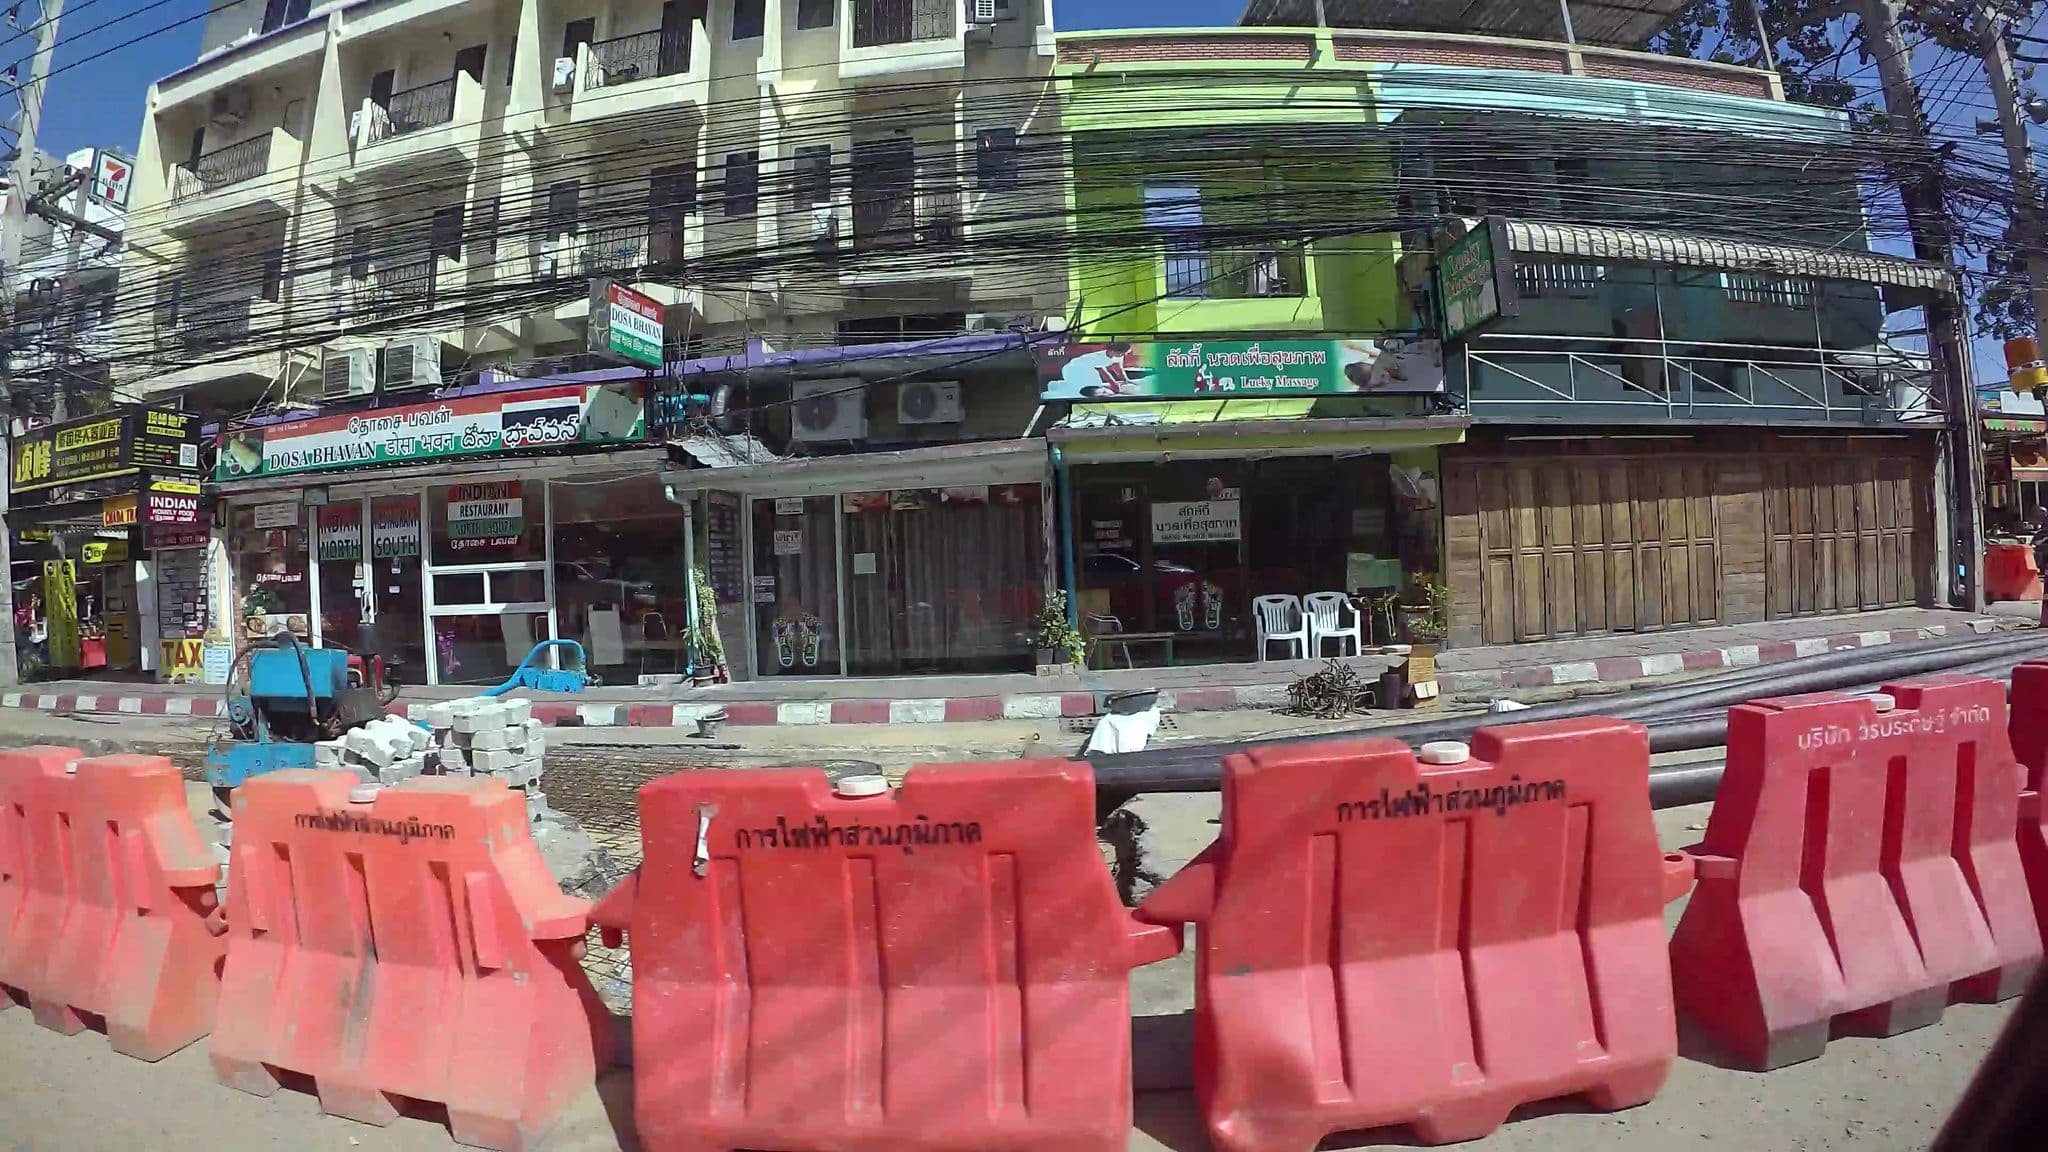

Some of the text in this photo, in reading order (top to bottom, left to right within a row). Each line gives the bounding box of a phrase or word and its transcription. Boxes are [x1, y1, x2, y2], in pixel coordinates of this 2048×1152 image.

[612, 308, 662, 341] DOSA BHAVAN
[1207, 343, 1327, 371] นวดเพื่อสุขภาพ
[1240, 375, 1320, 391] Lucky Massage
[349, 406, 451, 438] தோசை பவன்
[386, 432, 454, 454] डोसा भवन
[270, 441, 377, 469] DOSA BHAVAN
[459, 481, 507, 499] INDIAN
[150, 496, 197, 510] INDIAN
[460, 503, 508, 517] RESTAURANT
[320, 538, 360, 558] NORTH
[376, 535, 417, 556] SOUTH
[1336, 774, 1567, 822] การไฟฟ้าส่วนภูมิภาค
[735, 815, 983, 854] การไฟฟ้าส่วนภูมิภาค
